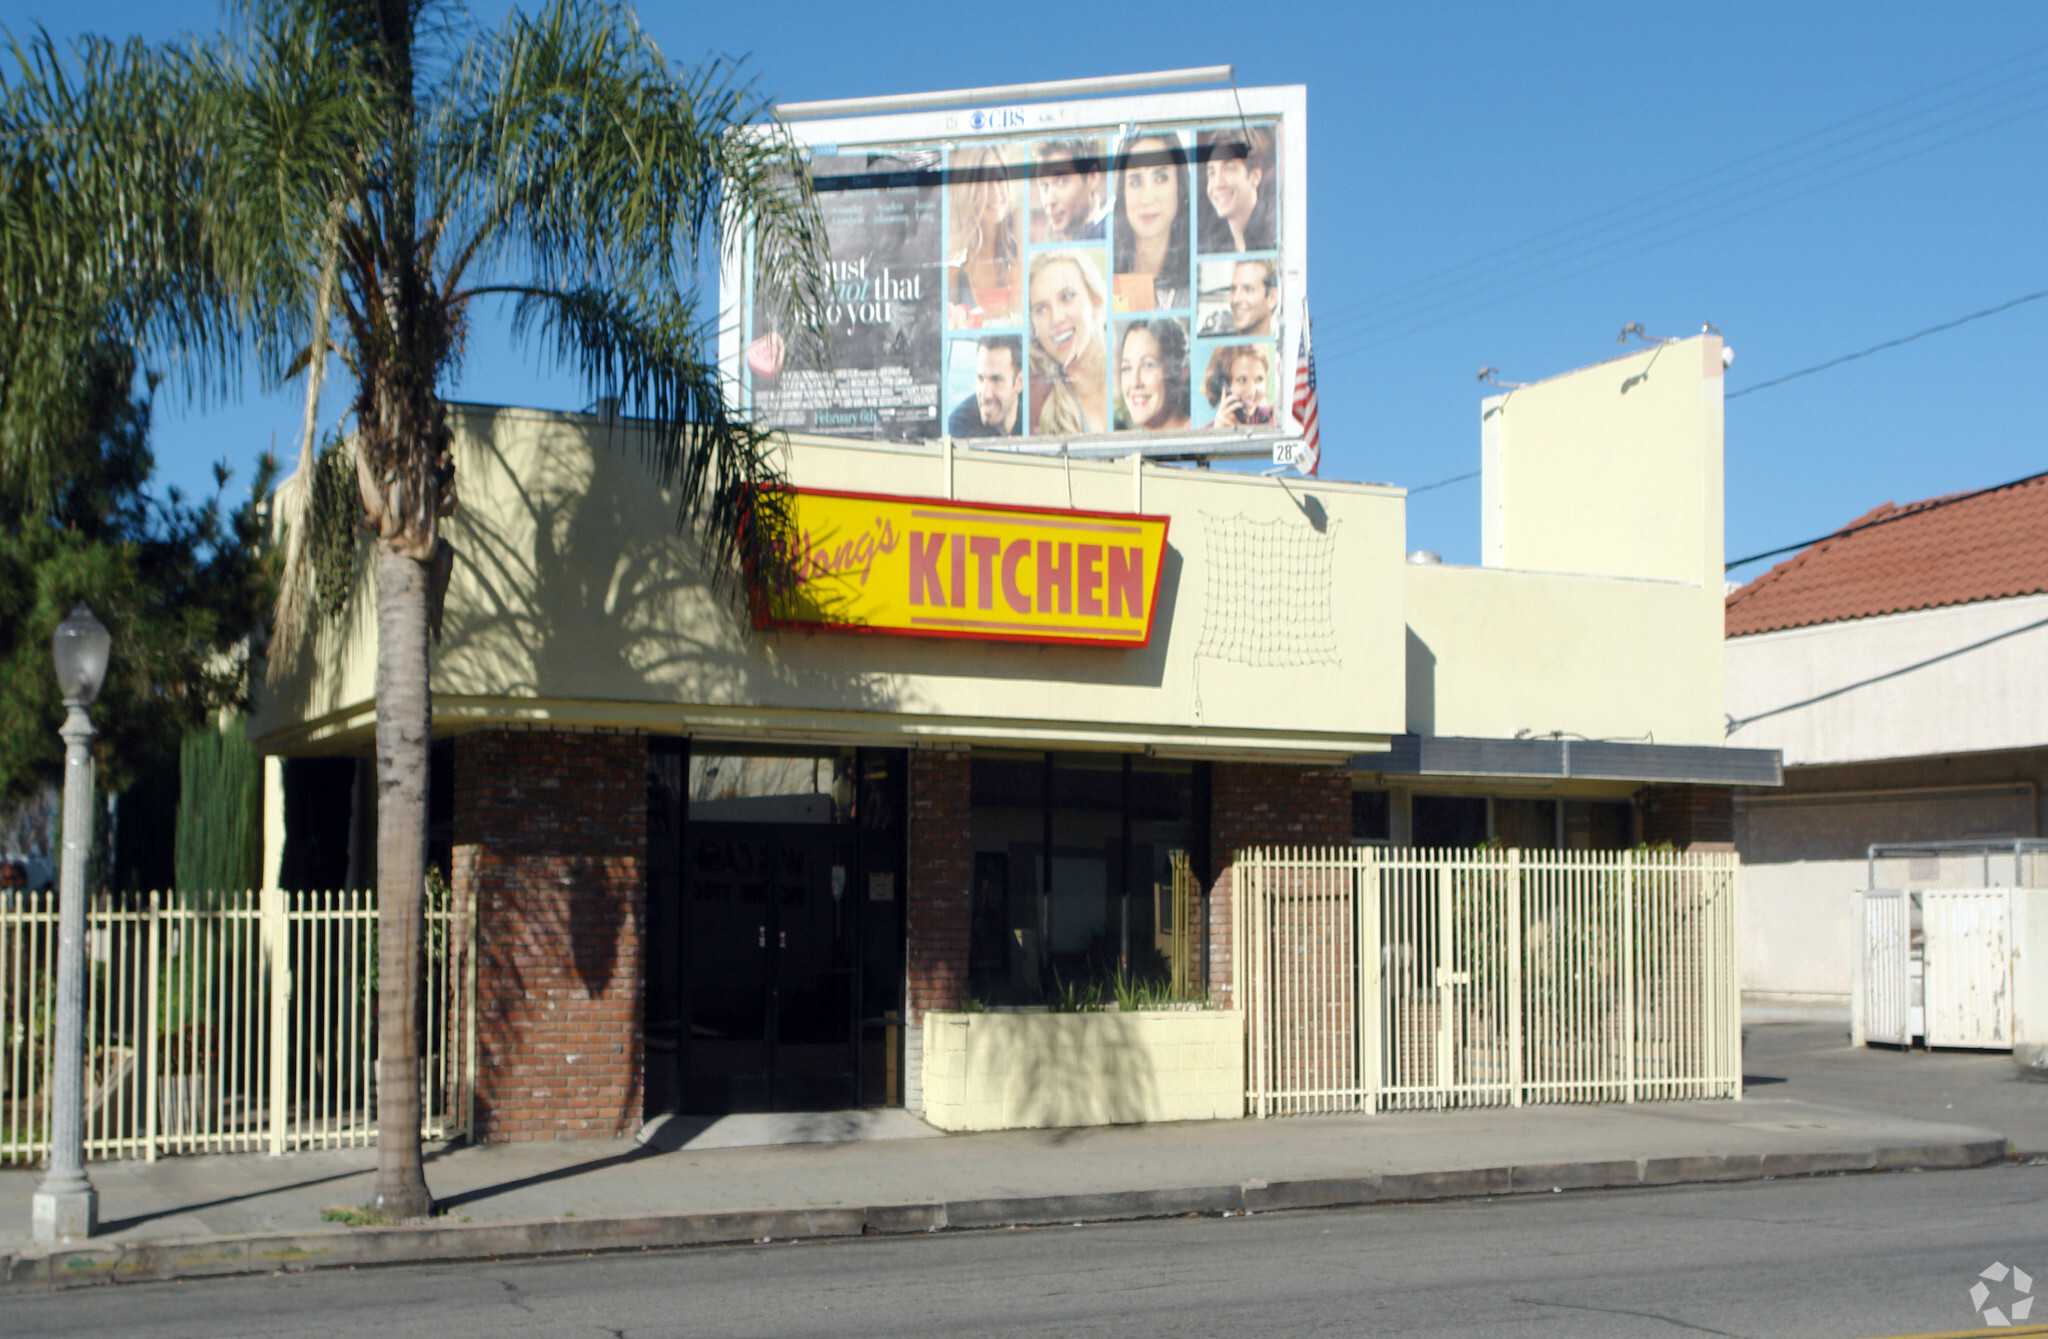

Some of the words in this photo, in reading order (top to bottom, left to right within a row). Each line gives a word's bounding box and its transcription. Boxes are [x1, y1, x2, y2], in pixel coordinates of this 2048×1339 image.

[988, 107, 1025, 129] CBS
[824, 256, 867, 294] just
[874, 267, 922, 301] that
[846, 302, 891, 337] you
[909, 531, 1143, 618] KITCHEN
